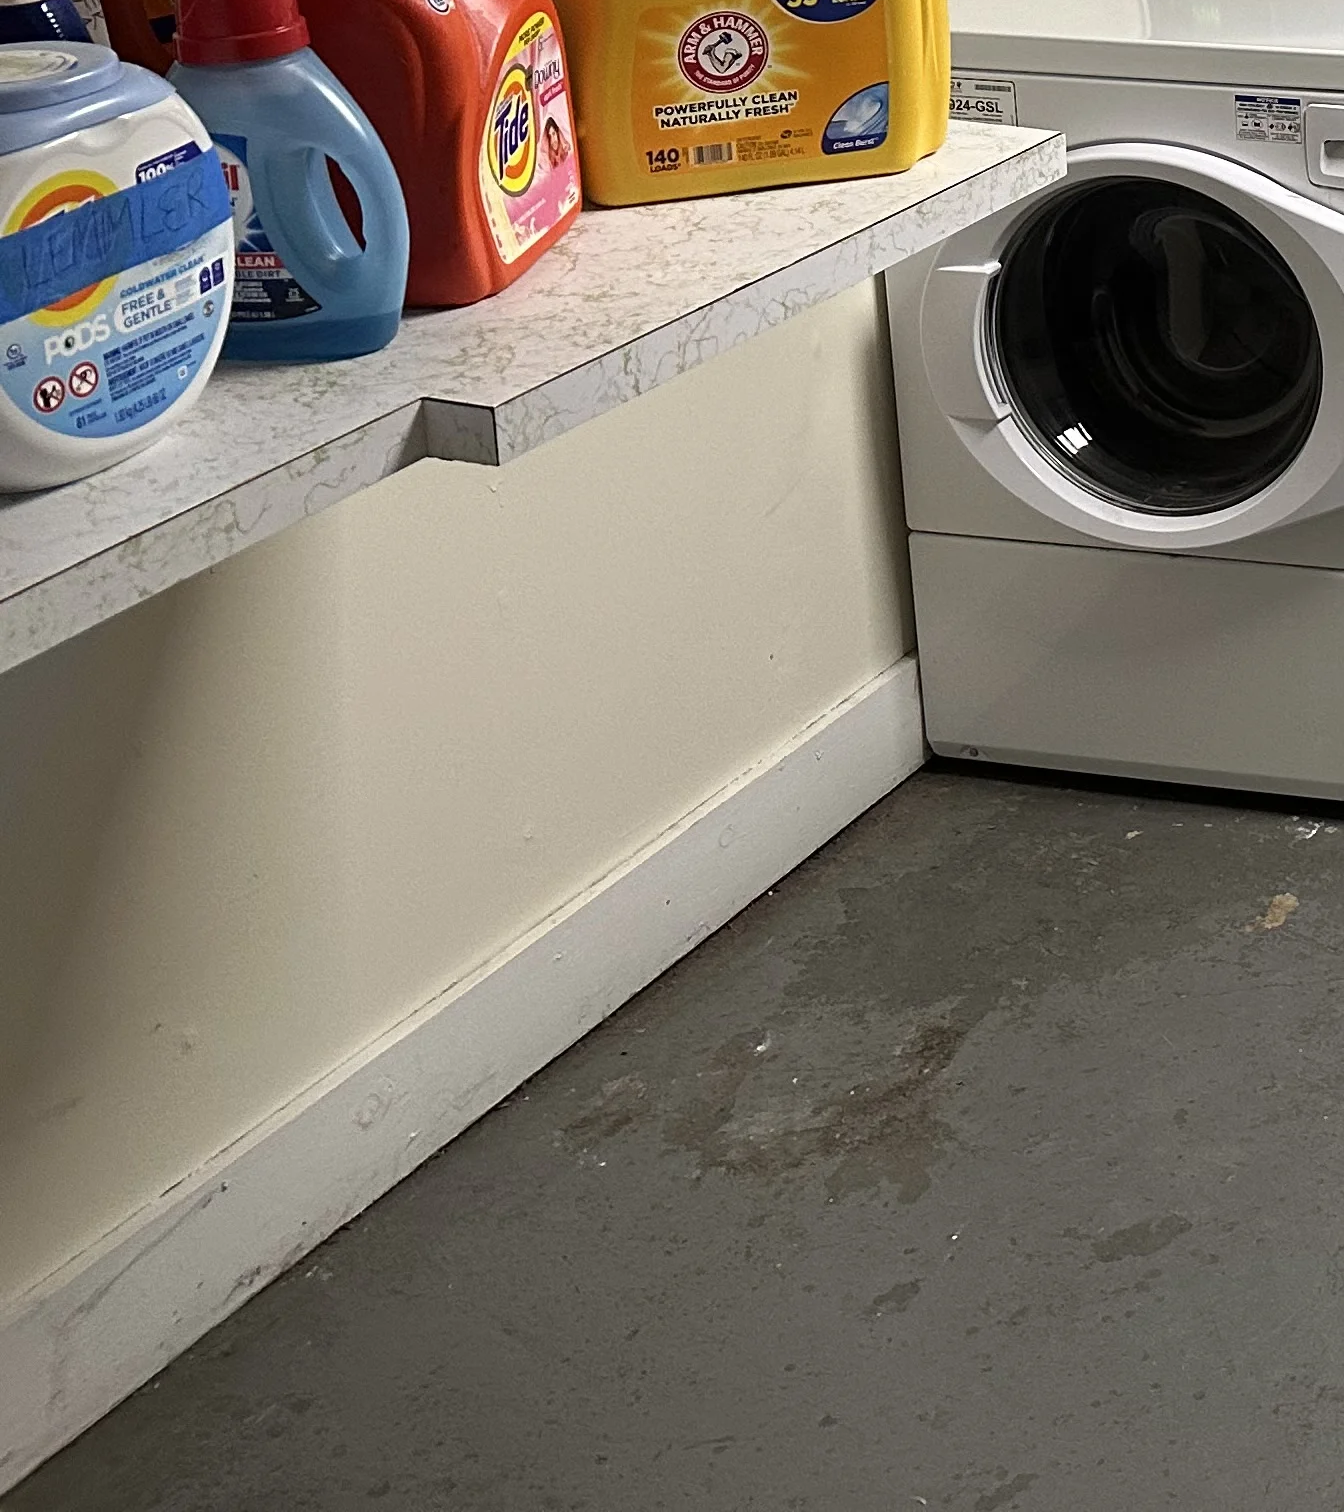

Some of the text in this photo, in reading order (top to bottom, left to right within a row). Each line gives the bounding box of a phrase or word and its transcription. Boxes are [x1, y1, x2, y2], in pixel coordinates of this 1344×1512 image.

[683, 16, 764, 64] ARM & HAMMER
[533, 59, 560, 89] Downy
[655, 91, 797, 117] POWERFULLY CLEAN
[949, 98, 1003, 114] 924-GSL
[660, 109, 741, 128] NATURALLY
[495, 96, 529, 180] Tide
[833, 139, 854, 150] Clean
[646, 148, 679, 165] 140
[237, 256, 275, 267] LEAN
[257, 270, 281, 278] DIRT
[120, 266, 177, 298] COLDWATER
[121, 291, 165, 315] FREE &
[123, 301, 173, 328] GENTLE
[43, 314, 111, 364] PODS
